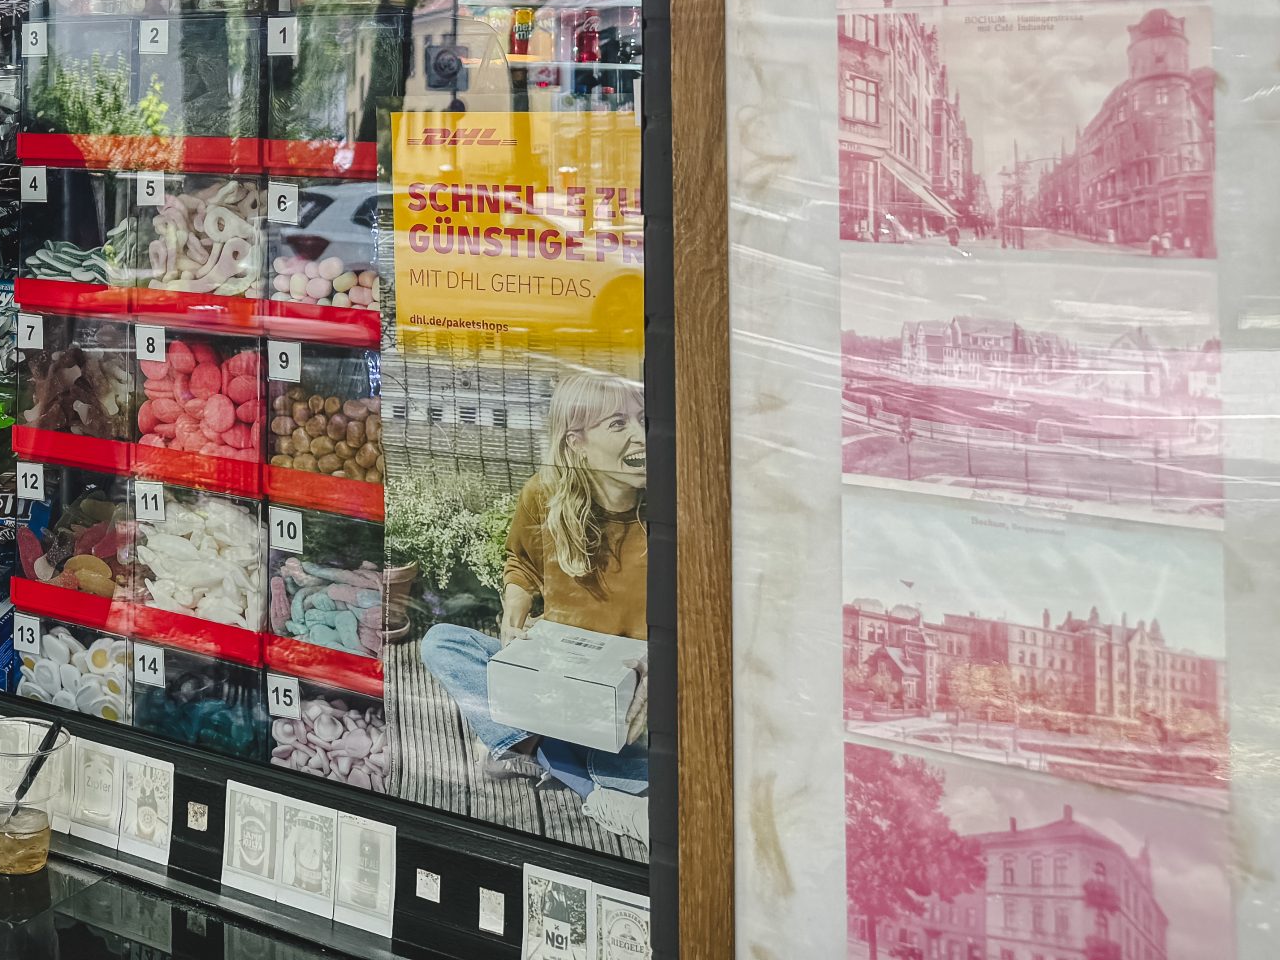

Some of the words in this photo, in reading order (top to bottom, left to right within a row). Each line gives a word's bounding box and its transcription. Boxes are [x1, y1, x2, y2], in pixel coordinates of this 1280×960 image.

[31, 31, 38, 46] 3
[150, 28, 158, 43] 2
[280, 27, 286, 43] 1
[421, 128, 501, 146] DHL
[30, 176, 38, 191] 4
[146, 181, 154, 196] 5
[278, 195, 286, 209] 6
[408, 182, 587, 218] SCHNELLE
[408, 216, 585, 262] GÜNSTIGE
[409, 269, 442, 288] MIT
[447, 271, 485, 291] DHL
[491, 273, 545, 294] GEHT
[551, 277, 596, 298] DAS.
[409, 314, 509, 333] dhl.de/paketshops
[27, 325, 34, 340] 7
[147, 337, 155, 353] 8
[279, 352, 289, 369] 9
[22, 473, 38, 489] 12
[142, 493, 158, 510] 11
[277, 520, 296, 539] 10
[18, 626, 34, 644] 13
[139, 655, 158, 674] 14
[272, 687, 293, 706] 15
